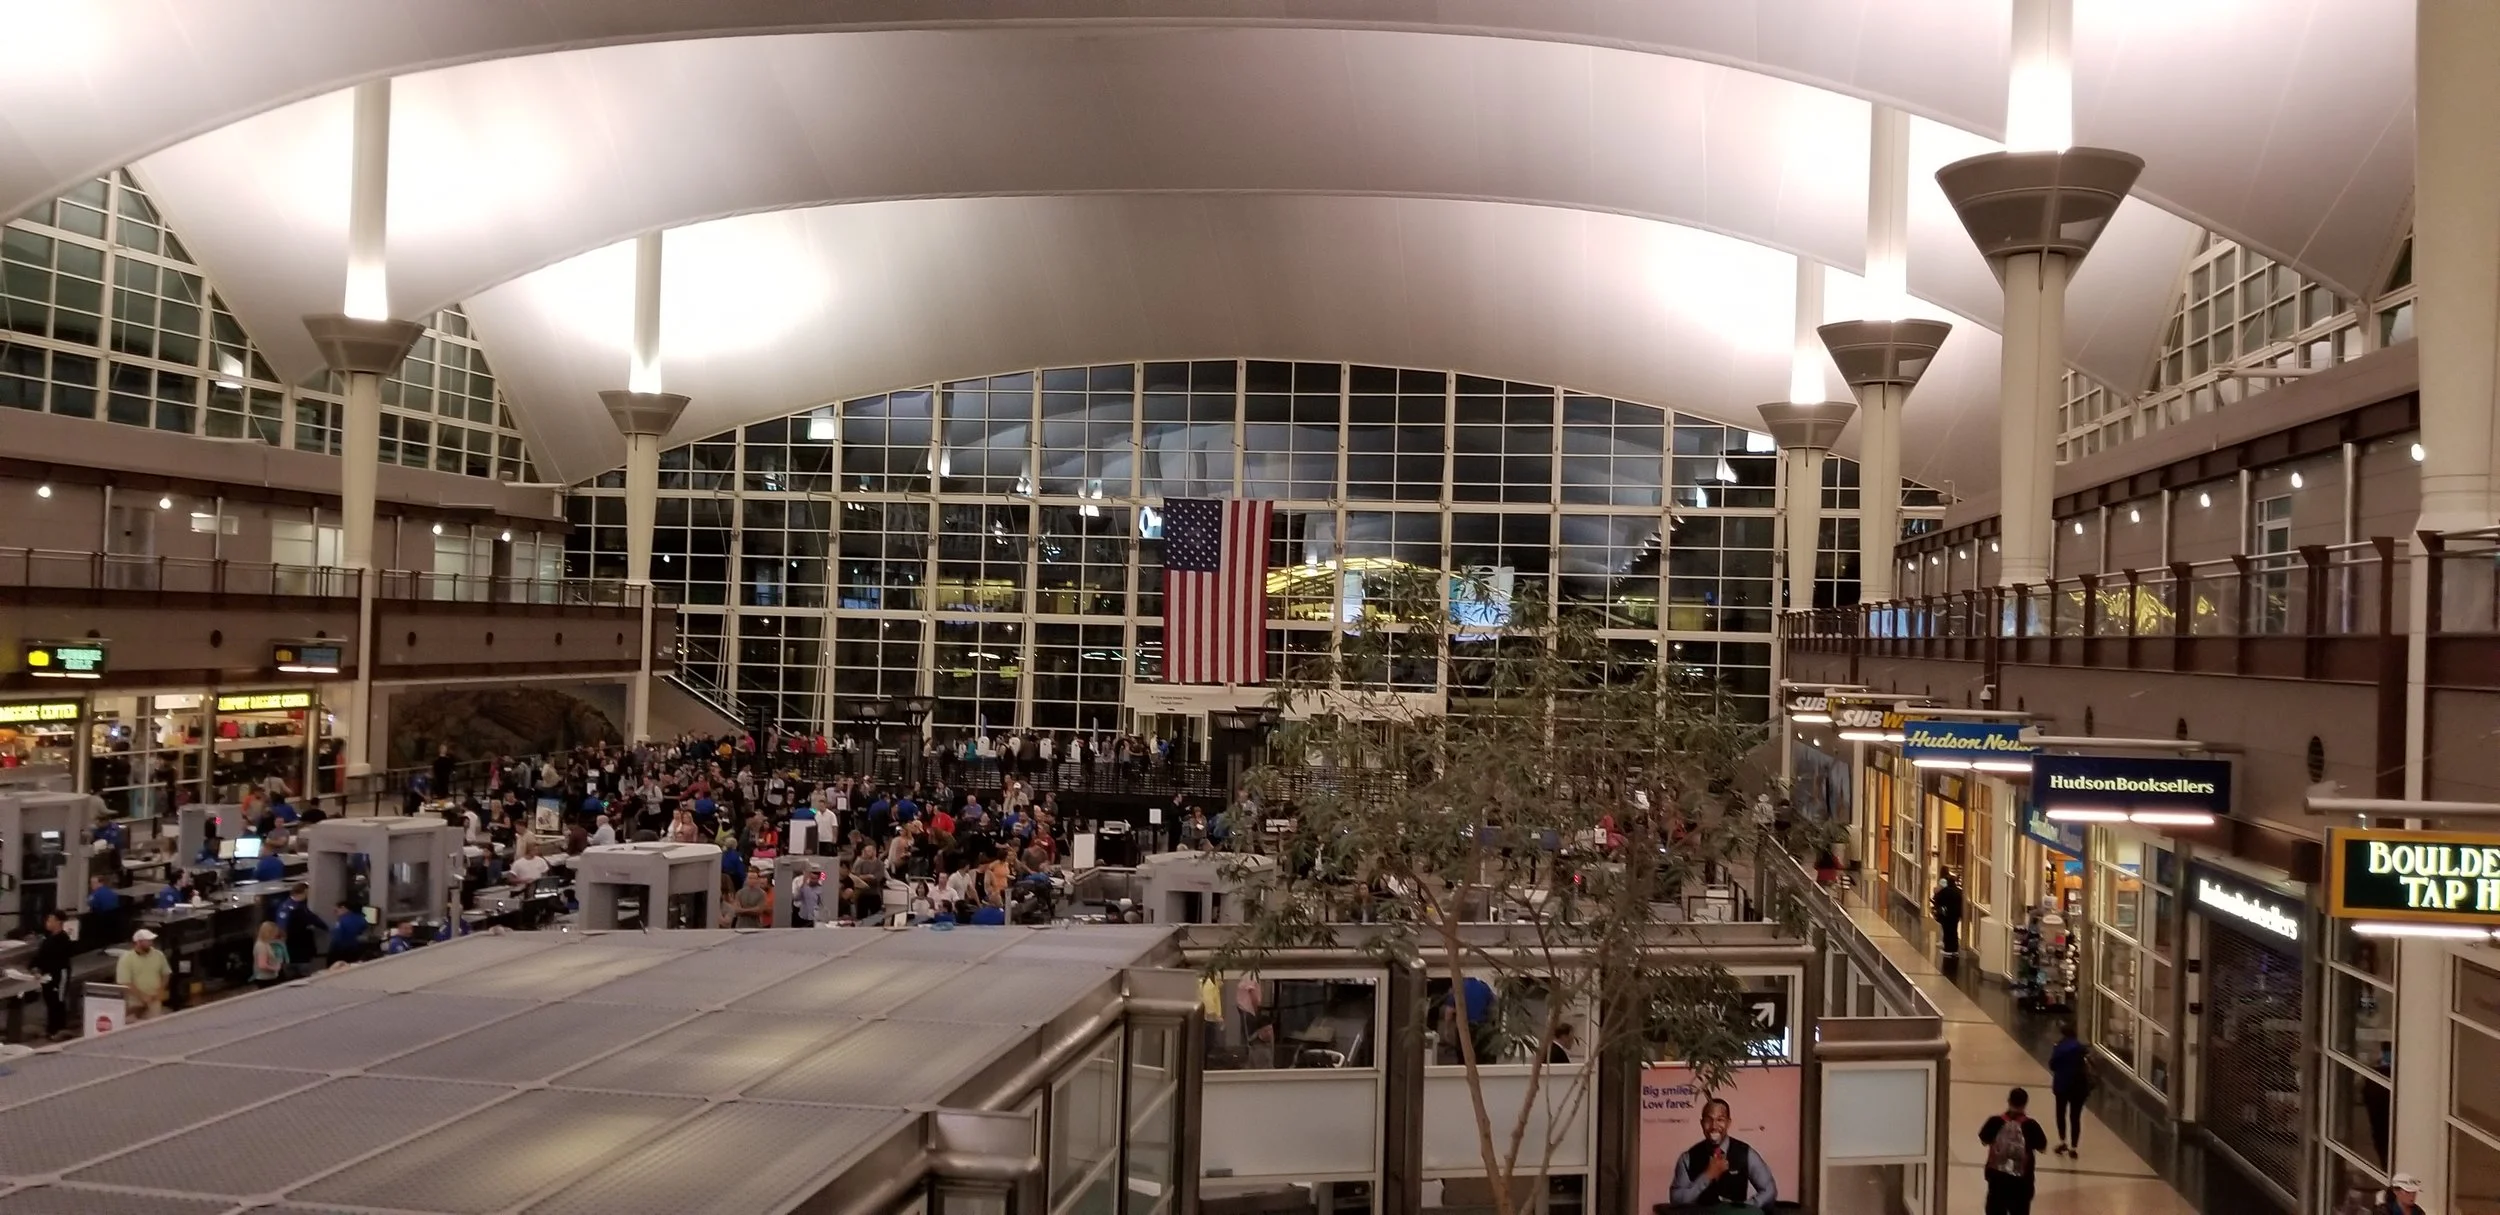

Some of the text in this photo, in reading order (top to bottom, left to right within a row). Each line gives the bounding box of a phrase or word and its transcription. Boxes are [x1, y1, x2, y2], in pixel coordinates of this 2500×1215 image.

[1836, 709, 1926, 729] SUBW
[1906, 730, 1981, 750] Hudson
[2050, 775, 2215, 795] HudsonBooksellers
[2368, 841, 2500, 878] BOULDE
[2399, 875, 2500, 911] TAP H
[1642, 1085, 1659, 1097] Big
[1642, 1100, 1664, 1109] Low
